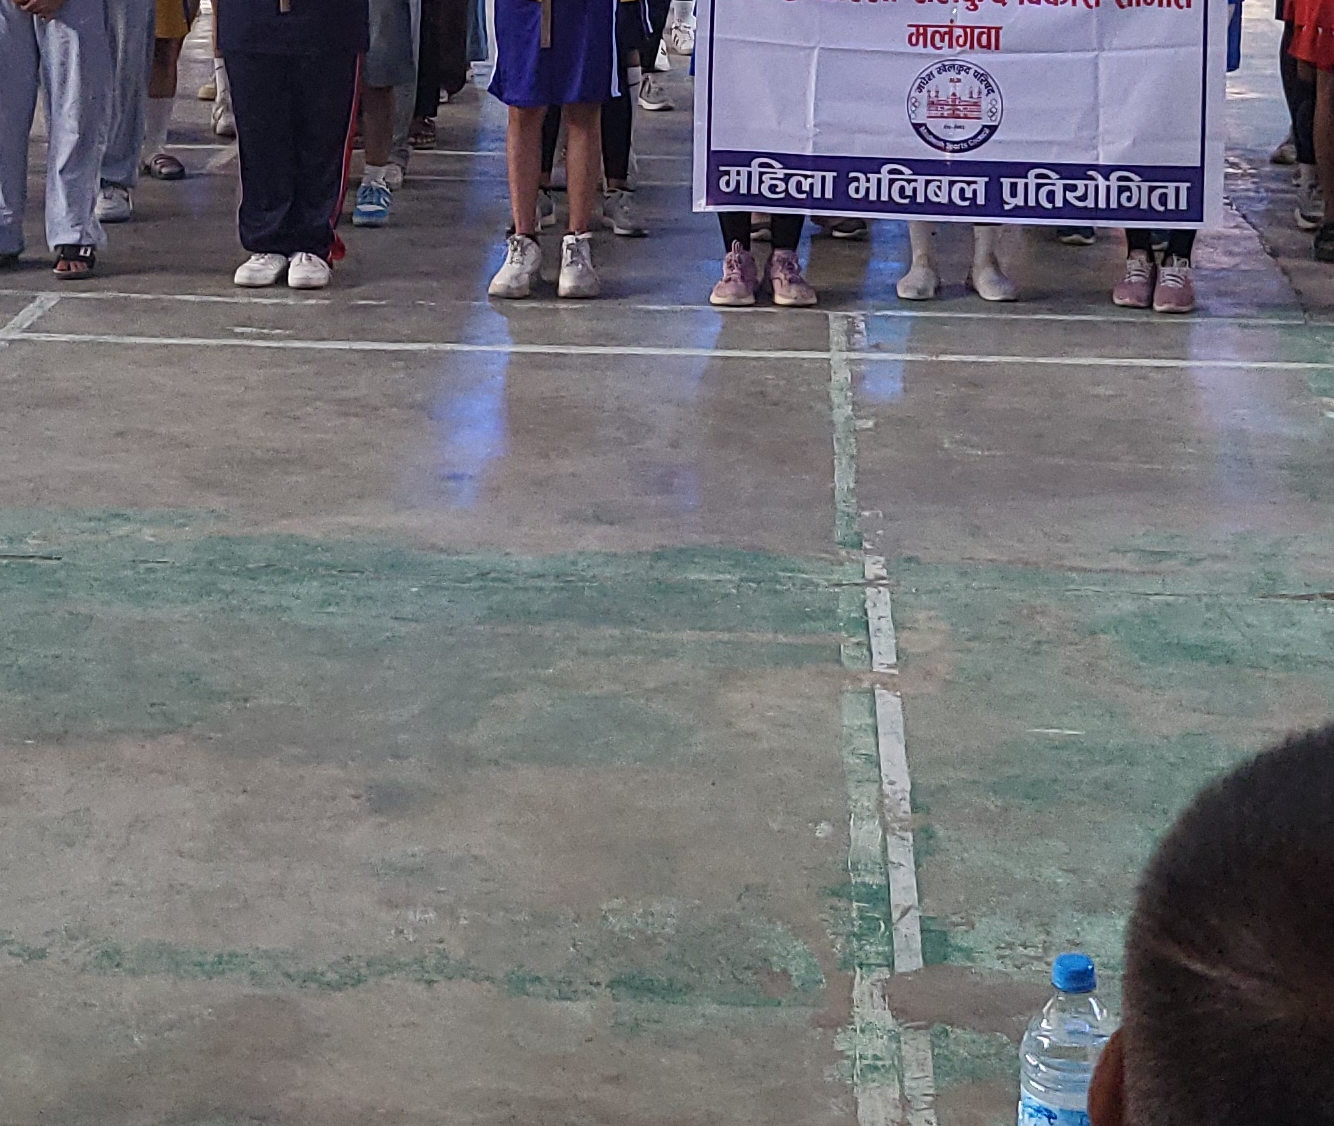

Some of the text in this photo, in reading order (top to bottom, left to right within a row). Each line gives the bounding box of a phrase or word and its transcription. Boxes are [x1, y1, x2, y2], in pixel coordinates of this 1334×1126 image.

[906, 18, 1004, 51] मलंगवा
[718, 157, 1192, 211] महिला भलिबल प्रतियोगिता
